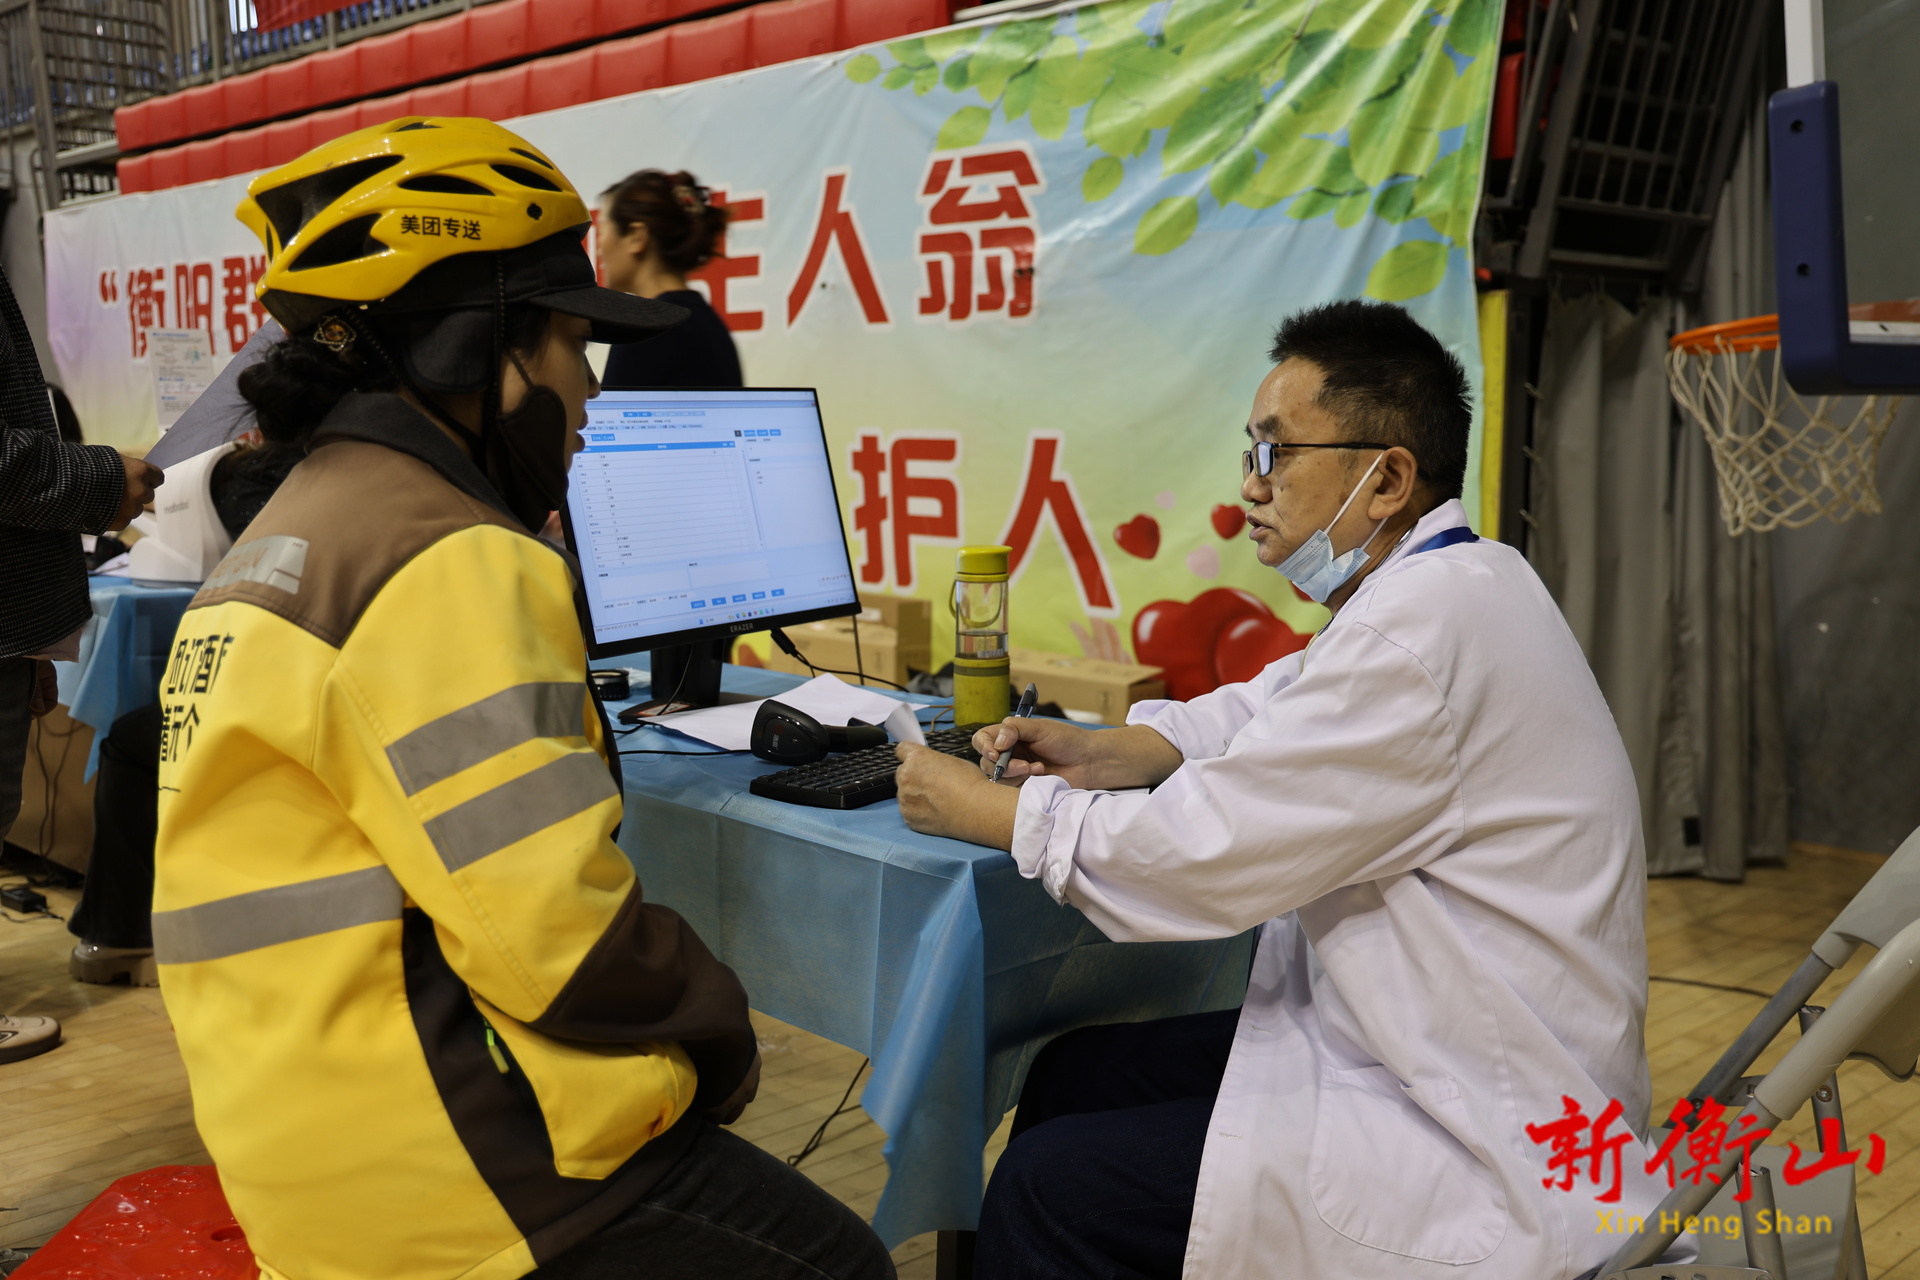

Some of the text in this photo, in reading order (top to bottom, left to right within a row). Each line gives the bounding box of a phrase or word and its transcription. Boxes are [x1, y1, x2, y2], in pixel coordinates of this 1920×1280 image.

[401, 215, 481, 240] 美团专送
[852, 435, 1114, 610] 护人
[730, 622, 754, 634] ERAZER
